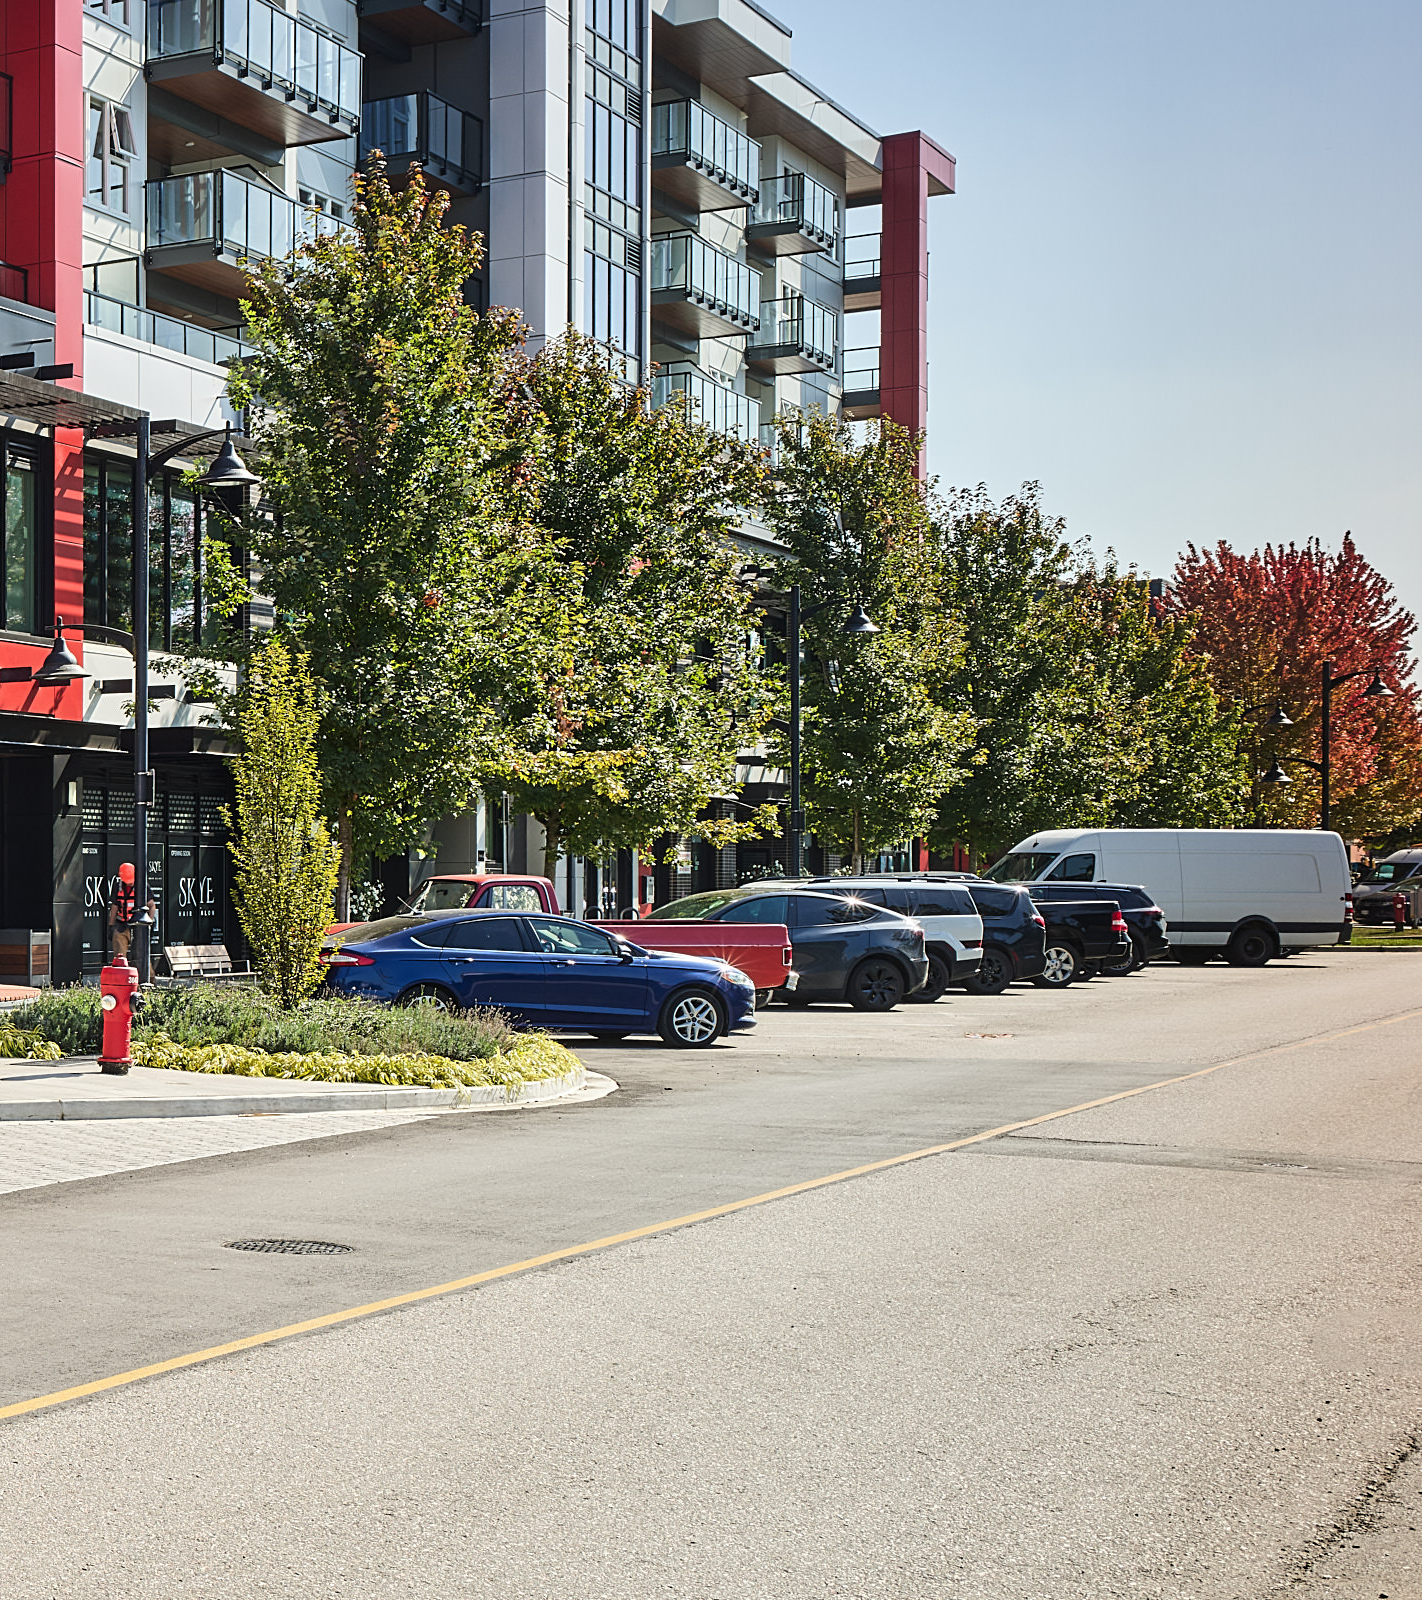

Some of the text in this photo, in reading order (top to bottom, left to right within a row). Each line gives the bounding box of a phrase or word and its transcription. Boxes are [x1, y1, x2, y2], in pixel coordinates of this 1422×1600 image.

[148, 861, 163, 873] SKYE
[84, 875, 121, 907] SKY
[178, 876, 215, 907] SKYE
